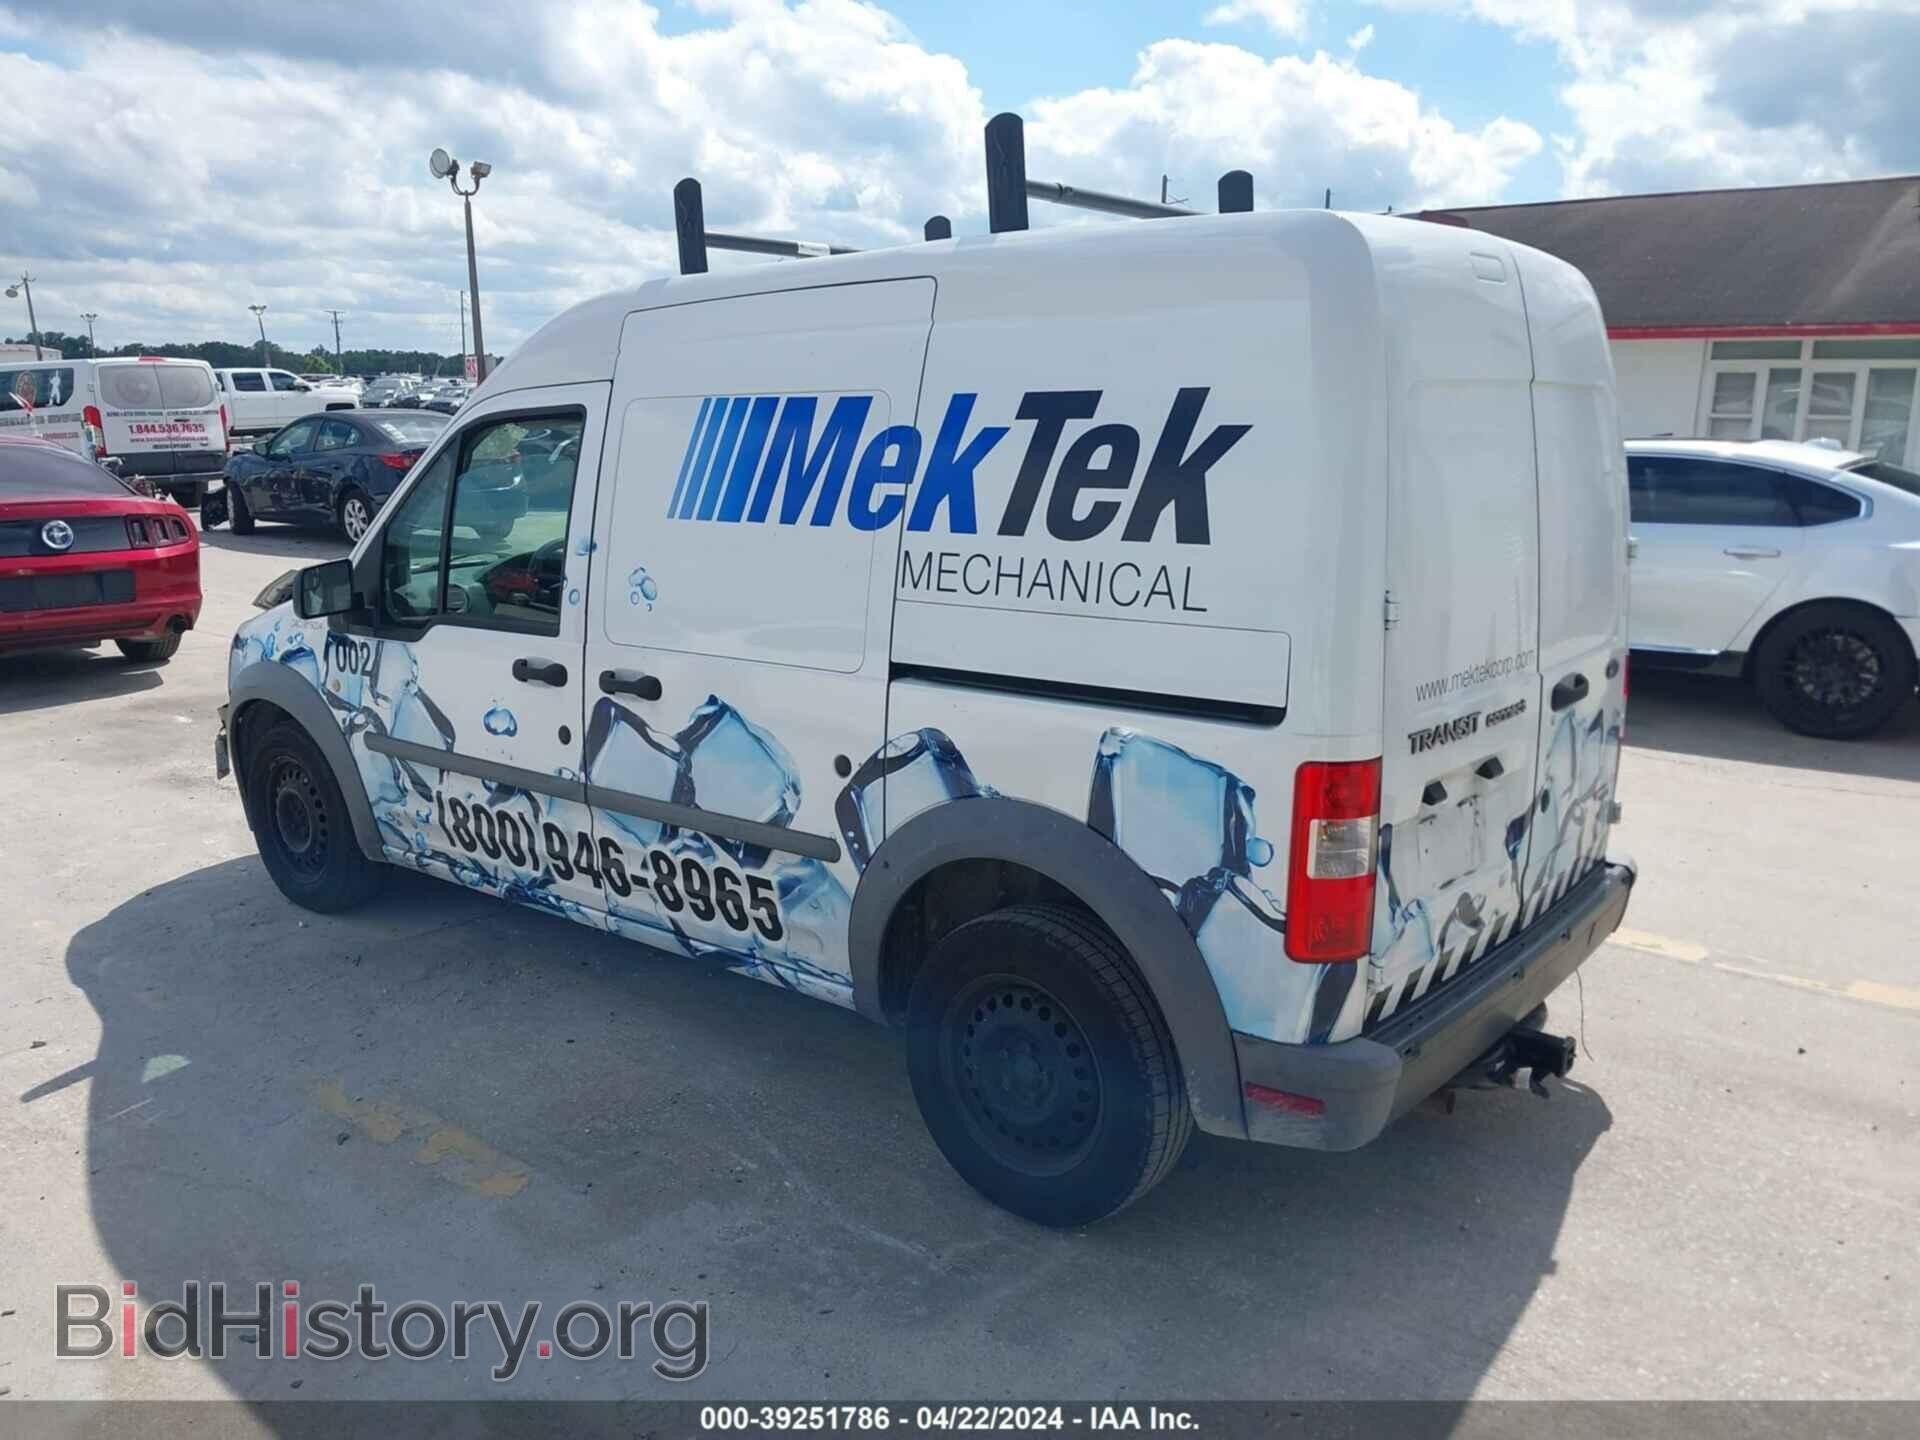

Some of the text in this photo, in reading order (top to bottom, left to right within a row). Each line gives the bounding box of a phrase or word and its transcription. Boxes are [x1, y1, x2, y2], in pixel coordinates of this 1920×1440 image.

[746, 387, 1254, 546] MekTek
[901, 549, 1209, 613] MECHANICAL
[335, 640, 373, 677] 002
[1407, 711, 1481, 755] TRANSIT
